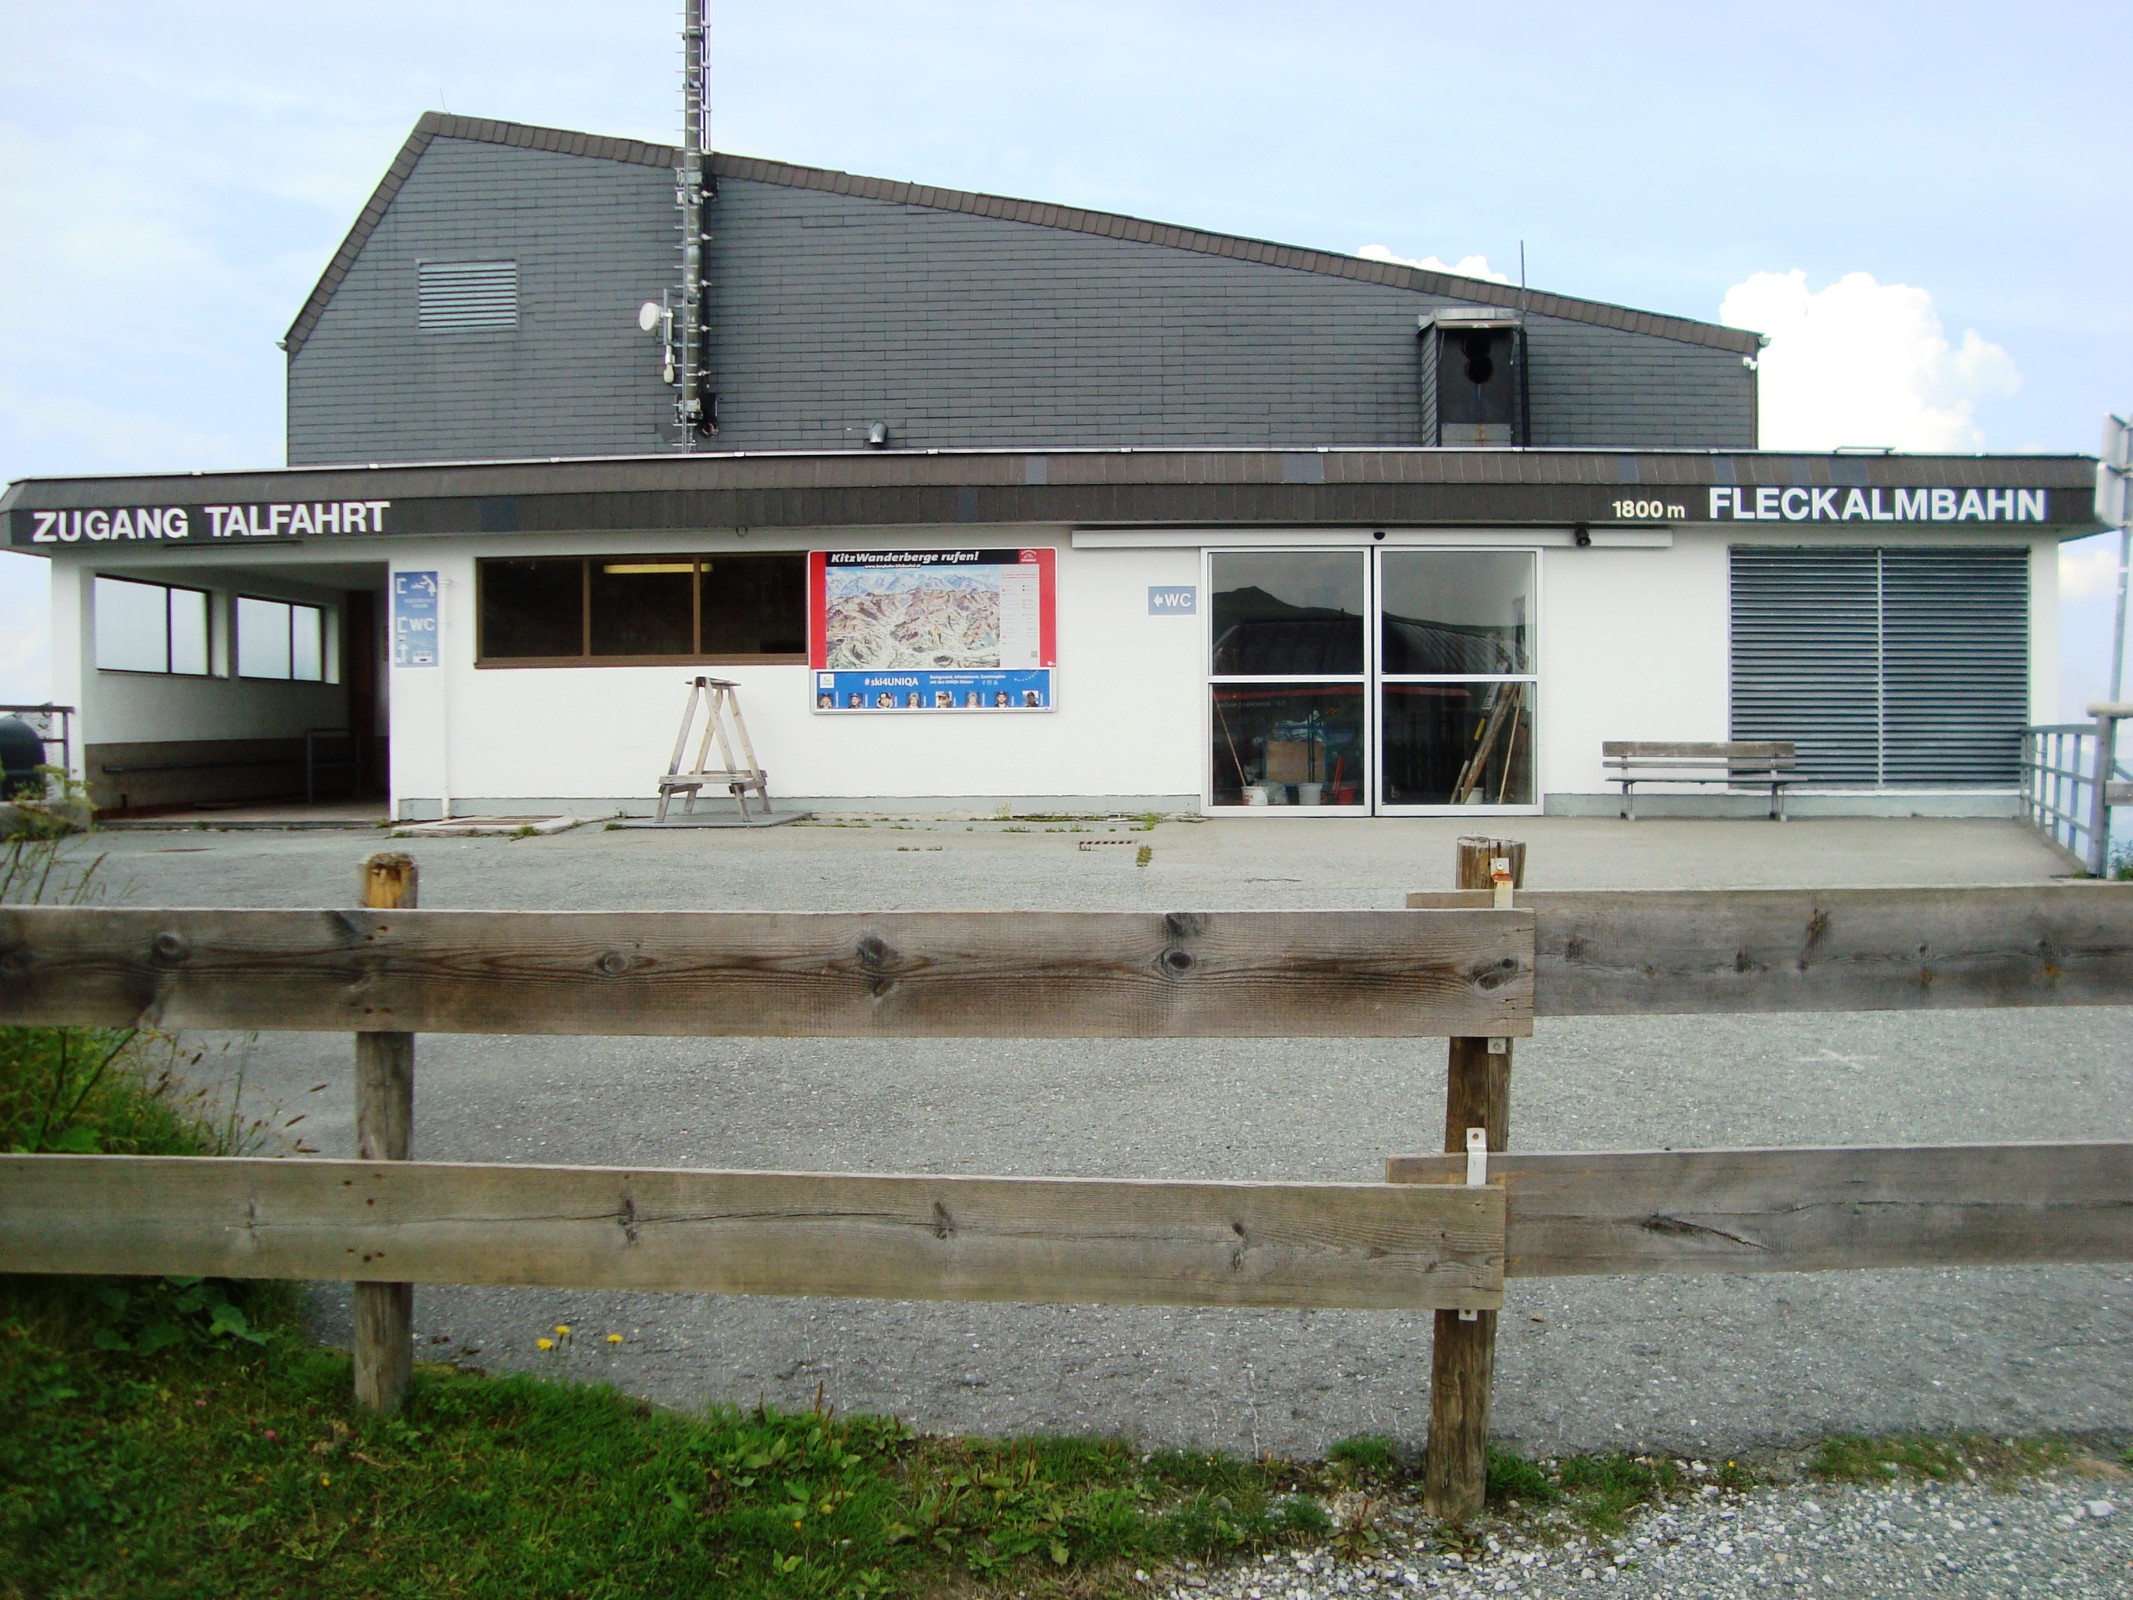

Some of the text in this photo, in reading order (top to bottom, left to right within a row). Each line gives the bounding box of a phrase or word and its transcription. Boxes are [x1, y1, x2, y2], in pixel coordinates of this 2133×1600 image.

[1612, 500, 1686, 519] 1800 m
[1708, 487, 2046, 521] FLECKALMBAHN
[32, 501, 391, 543] ZUGANG TALFAHRT
[830, 551, 980, 564] KitzWanderberge rufen!
[1164, 593, 1191, 607] WC
[408, 617, 436, 632] WC
